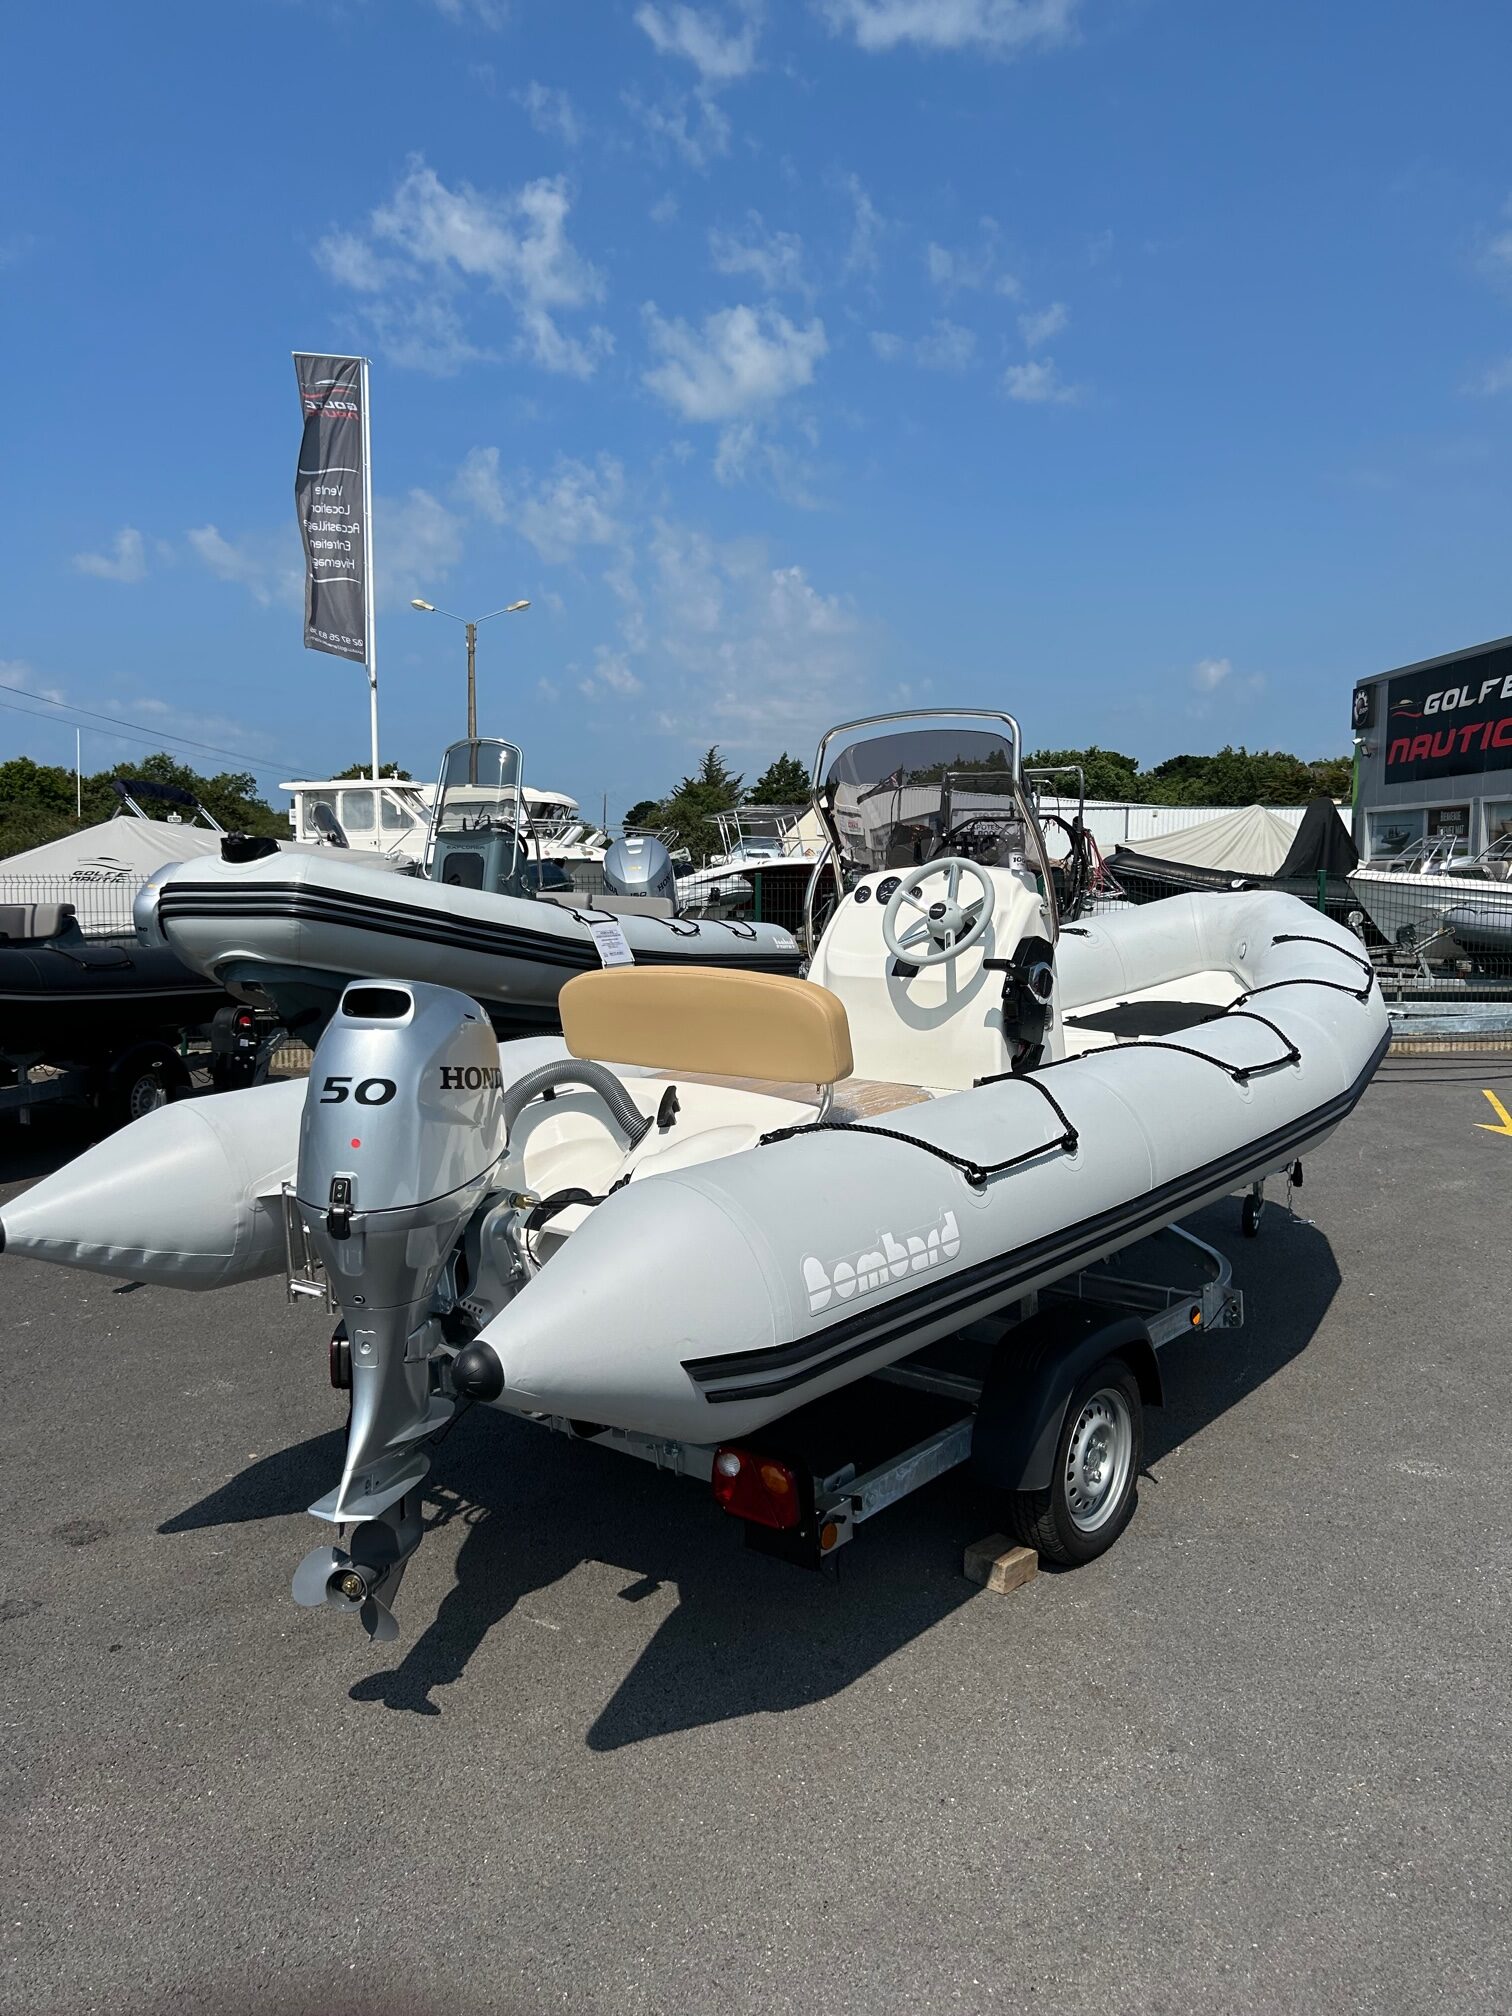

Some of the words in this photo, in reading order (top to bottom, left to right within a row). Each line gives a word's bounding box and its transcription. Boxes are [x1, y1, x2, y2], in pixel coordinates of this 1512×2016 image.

[1423, 675, 1512, 716] GOLFE
[320, 1076, 397, 1106] 50
[803, 1210, 961, 1311] Bombard
